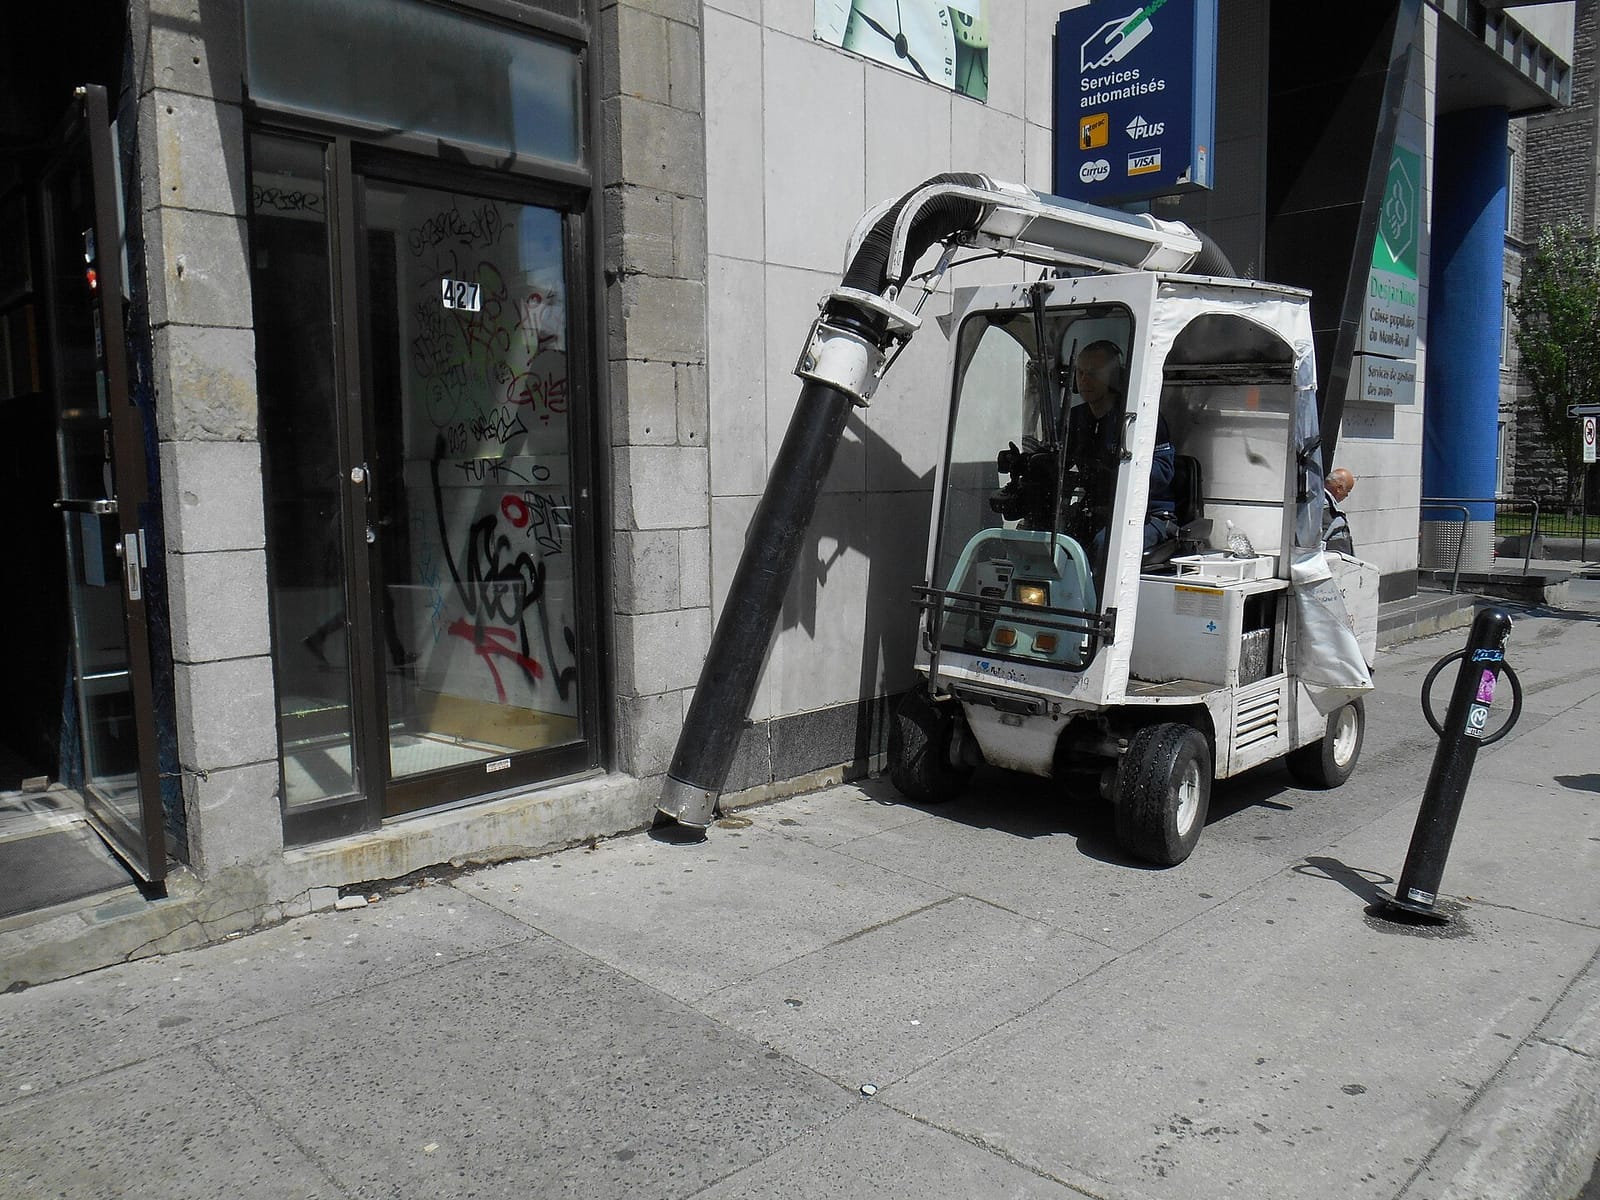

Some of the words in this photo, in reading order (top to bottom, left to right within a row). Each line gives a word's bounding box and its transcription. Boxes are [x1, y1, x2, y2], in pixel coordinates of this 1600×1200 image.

[1080, 69, 1140, 91] Services
[1080, 79, 1166, 108] automatisés
[1135, 122, 1165, 140] PLUS
[1133, 156, 1155, 168] VISA
[443, 280, 479, 309] 427
[1370, 275, 1416, 307] Desjardins
